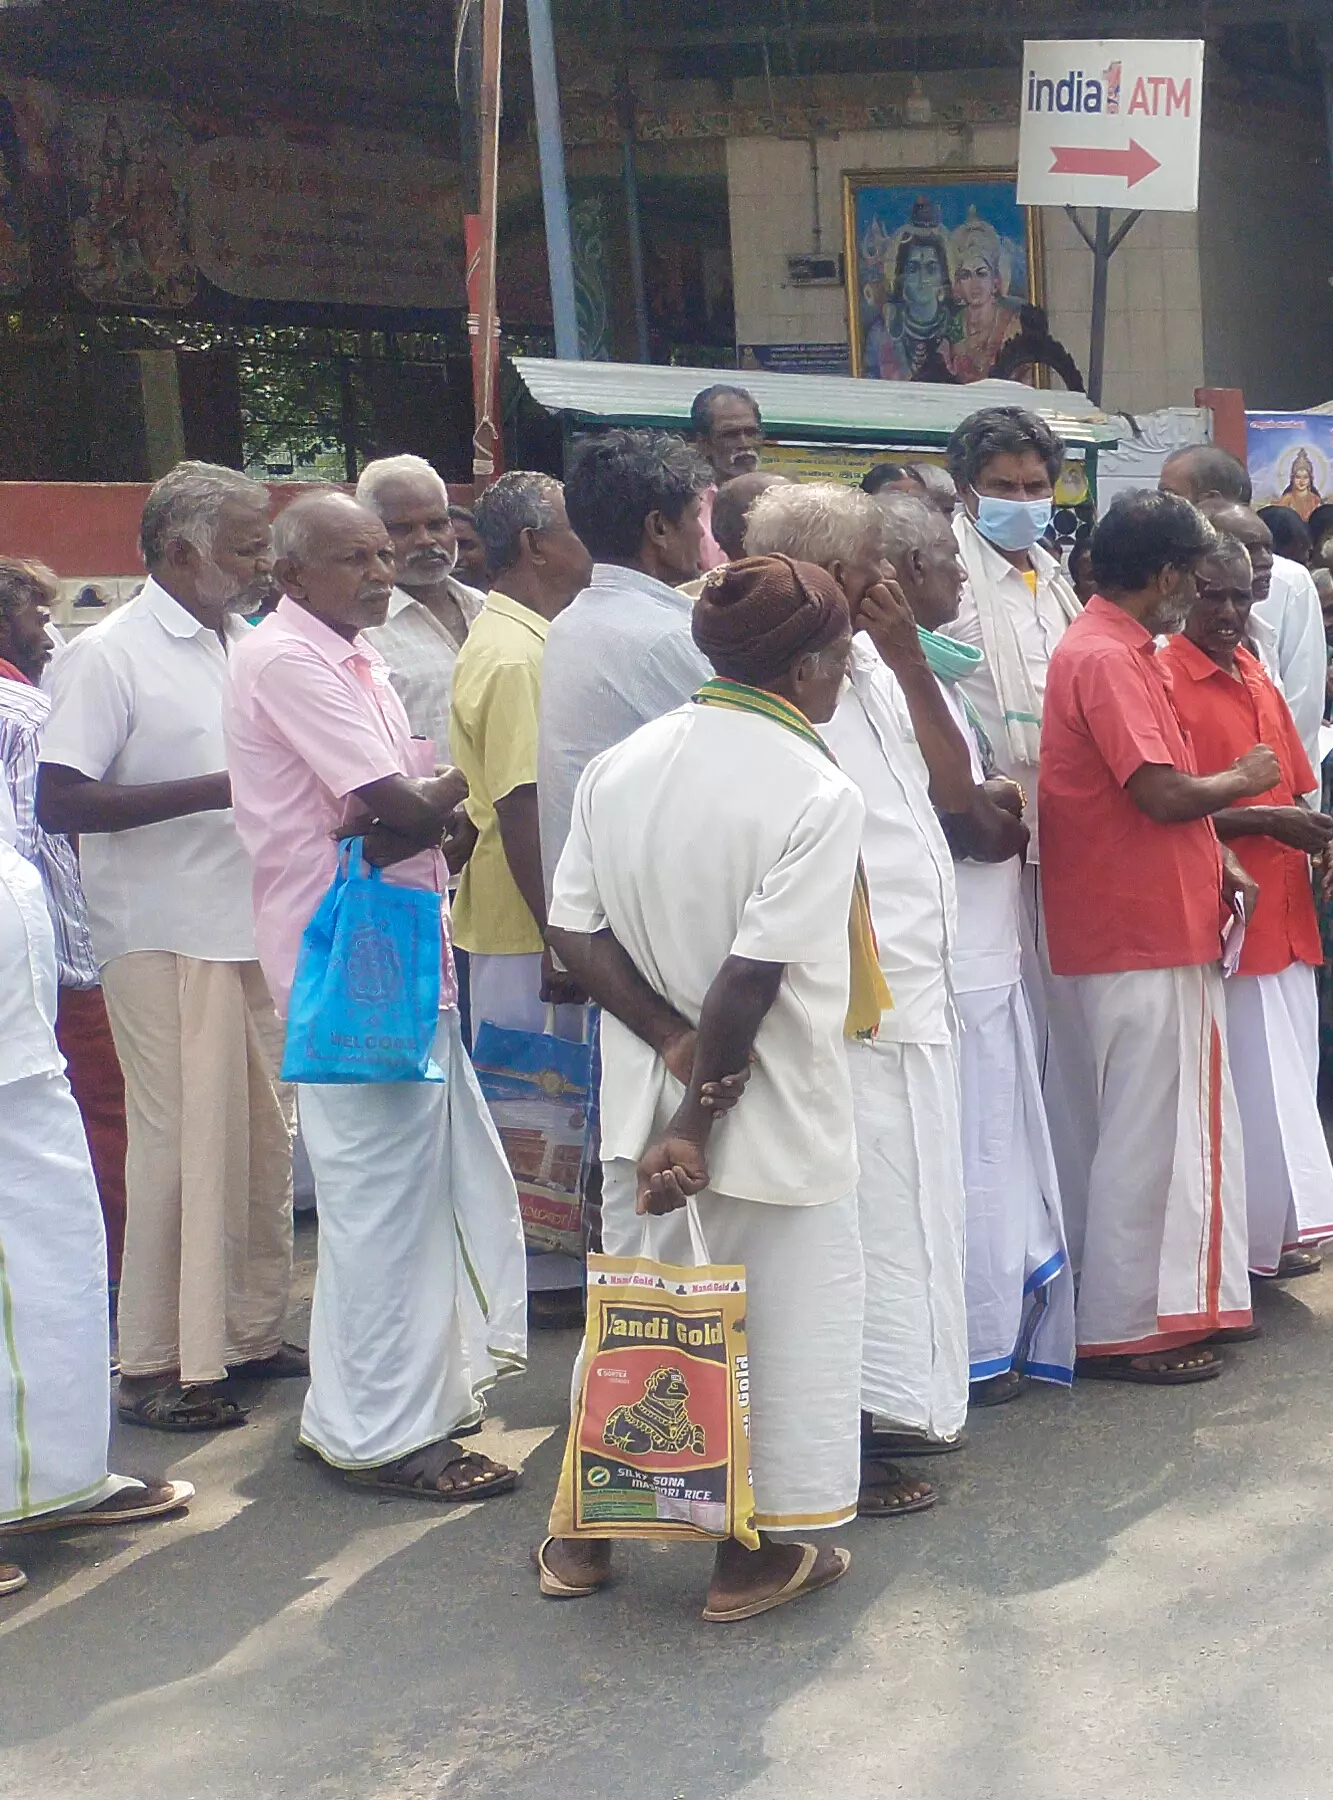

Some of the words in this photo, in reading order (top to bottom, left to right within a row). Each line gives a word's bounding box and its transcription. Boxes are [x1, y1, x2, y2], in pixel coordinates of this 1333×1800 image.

[1127, 77, 1192, 117] ATM
[633, 1276, 653, 1286] Gold
[607, 1313, 669, 1340] andi
[676, 1322, 724, 1346] Gold
[617, 1467, 648, 1480] SILKY
[653, 1476, 685, 1488] SONA
[684, 1490, 712, 1500] RICE
